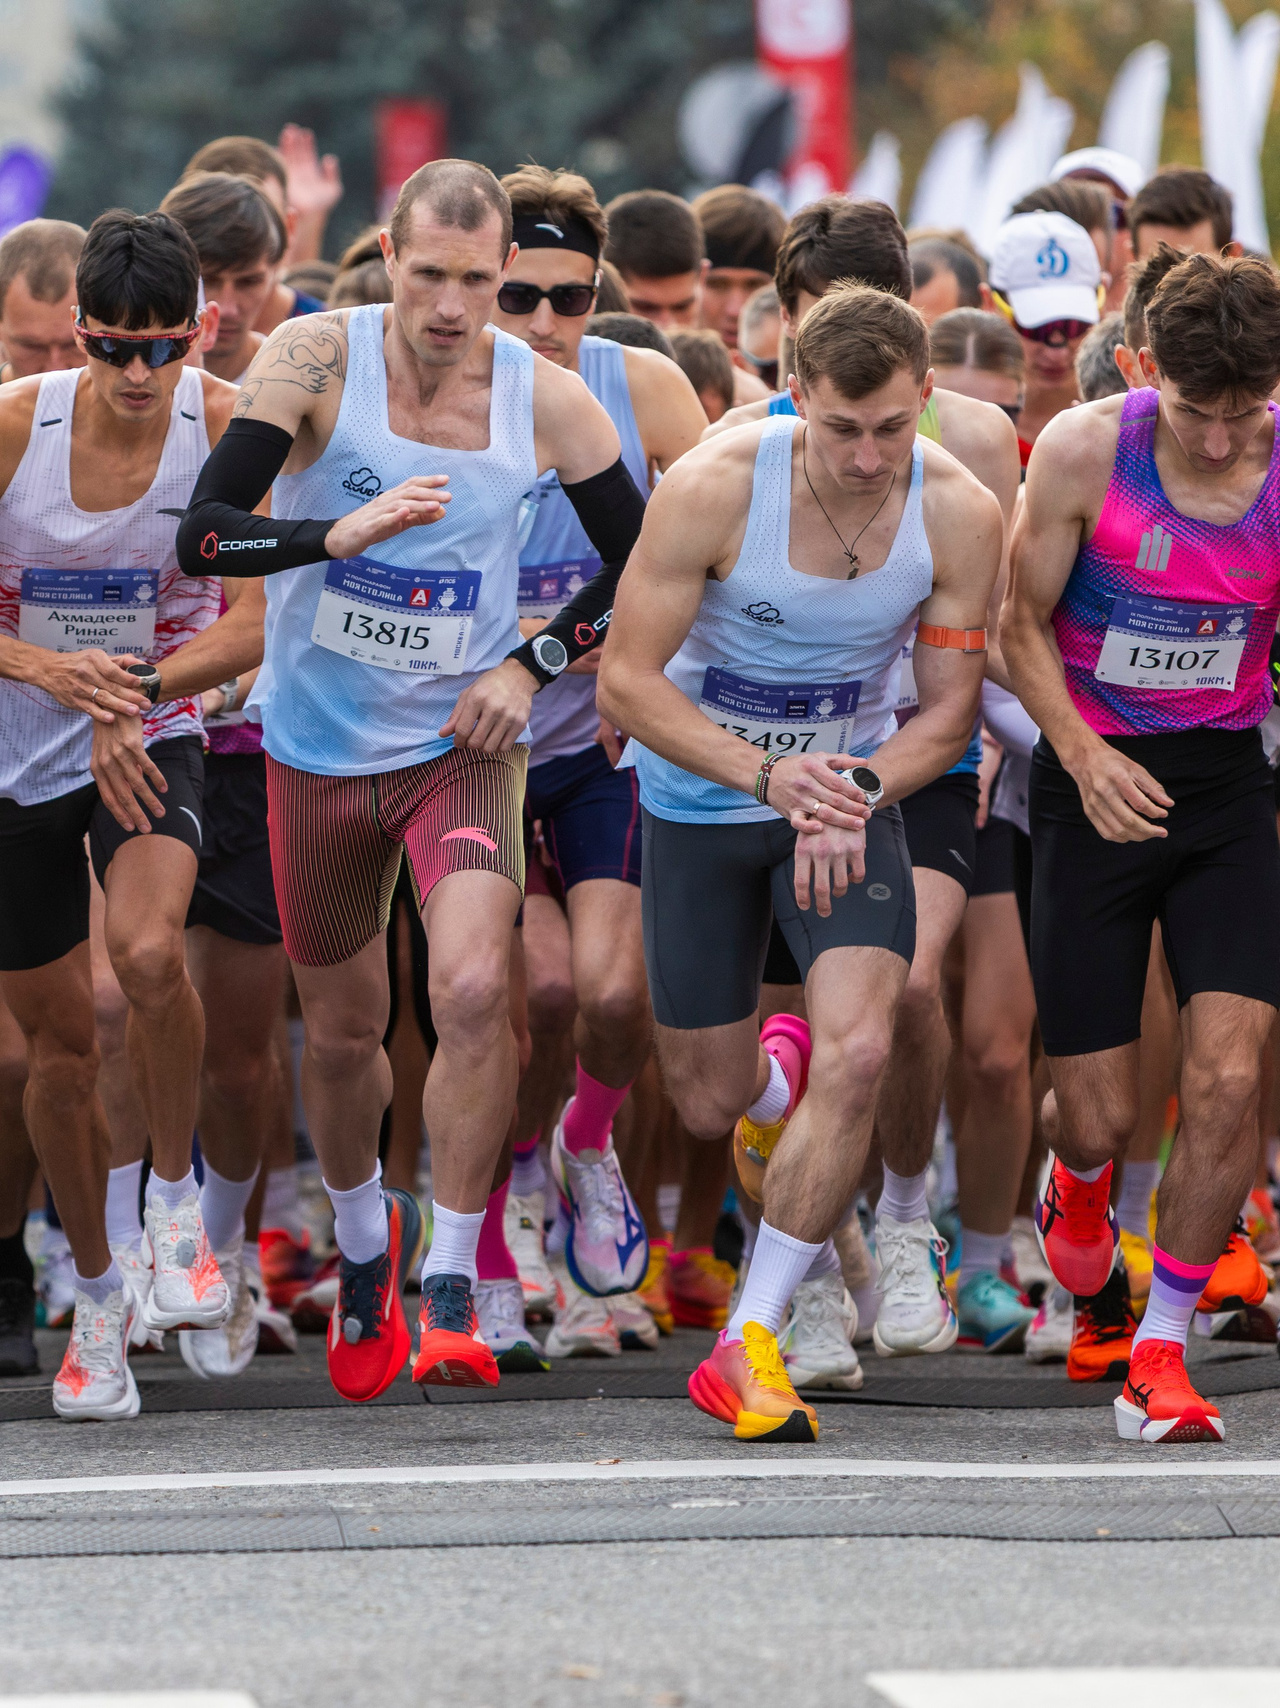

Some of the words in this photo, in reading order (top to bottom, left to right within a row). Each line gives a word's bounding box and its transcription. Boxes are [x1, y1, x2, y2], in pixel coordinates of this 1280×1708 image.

[218, 538, 278, 551] COROS
[32, 591, 50, 599] МОЯ
[51, 592, 93, 600] СТОЛИЦА
[342, 579, 360, 591] МОЯ
[361, 585, 403, 602] СТОЛИЦА
[47, 610, 137, 624] Ахмадеев
[1128, 618, 1147, 628] МОЯ
[1147, 622, 1190, 633] СТОЛИЦА
[64, 624, 119, 636] Ринас
[343, 611, 431, 650] 13815
[453, 631, 465, 659] МОСКВА
[1129, 646, 1220, 670] 13107
[717, 694, 735, 706] МОЯ
[736, 702, 779, 714] СТОЛИЦА
